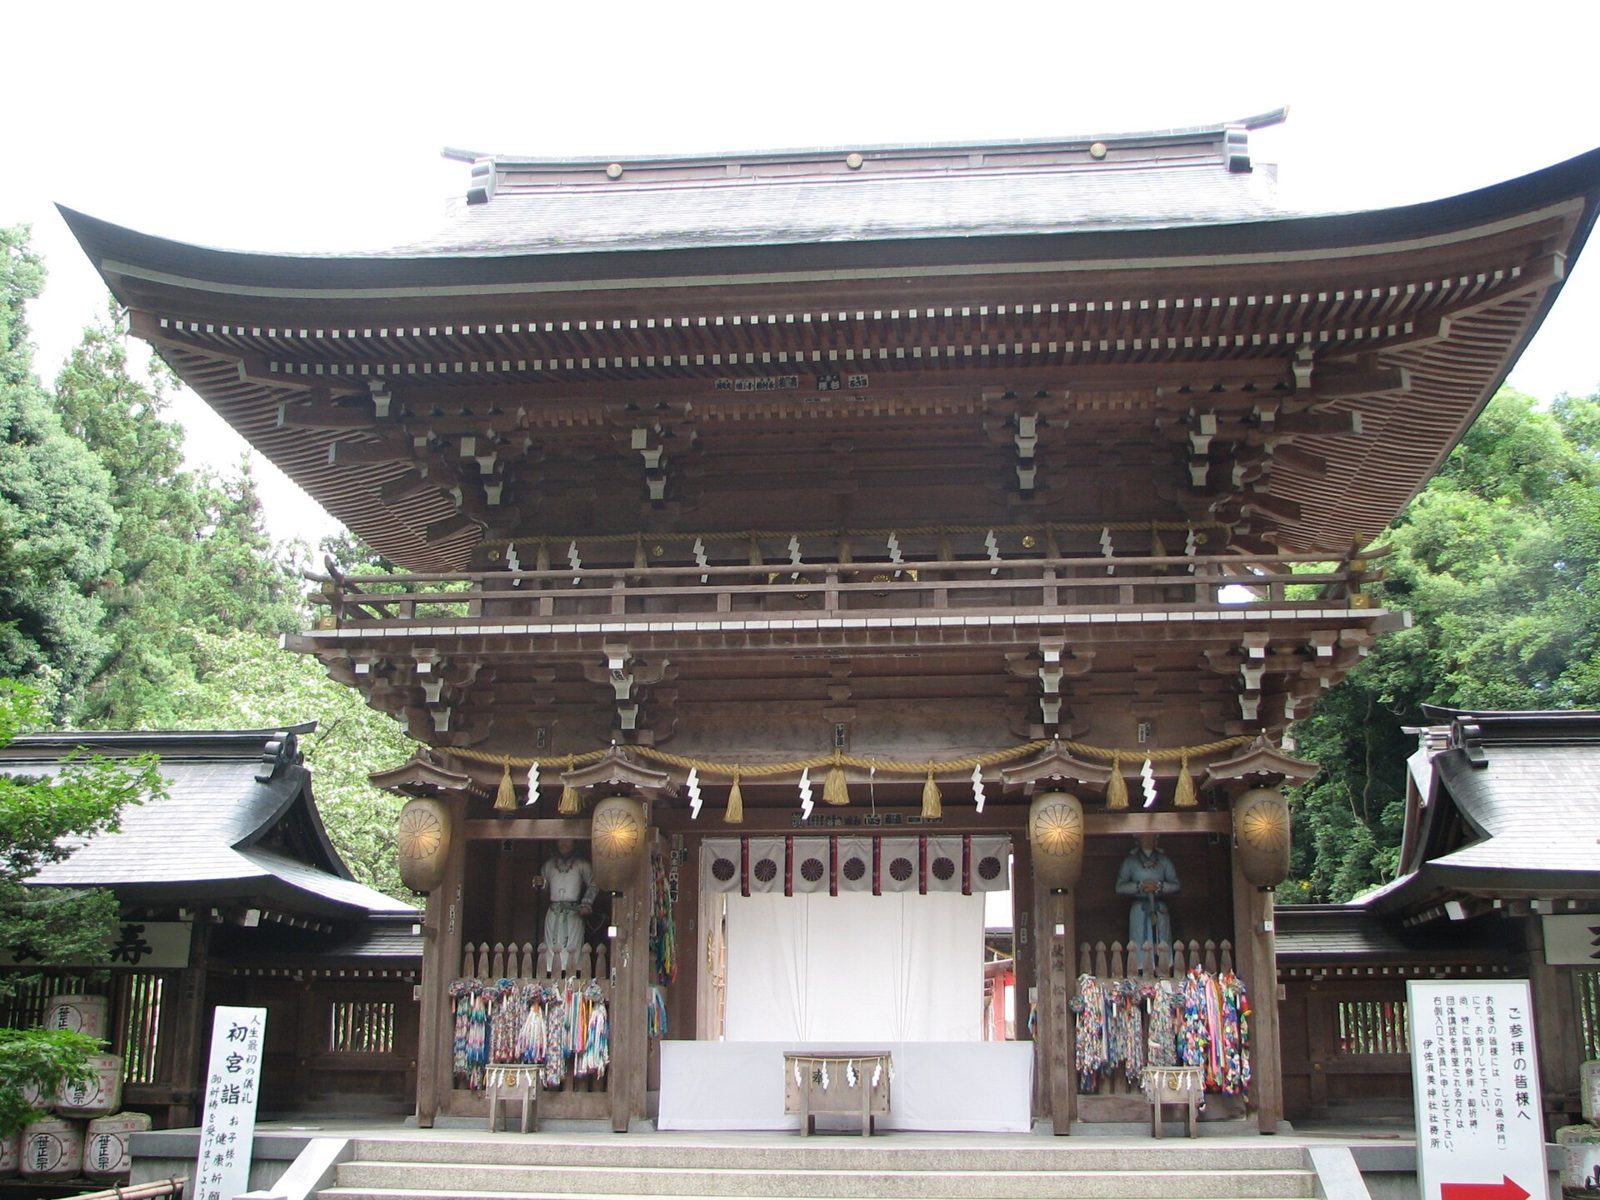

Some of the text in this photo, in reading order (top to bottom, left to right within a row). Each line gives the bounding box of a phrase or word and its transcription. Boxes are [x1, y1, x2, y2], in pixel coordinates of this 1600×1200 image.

[220, 1022, 248, 1105] 初宮詣
[241, 1015, 261, 1104] 人生最初の儀礼
[1423, 1039, 1440, 1149] 伊佐須美神社社務所
[1508, 1007, 1531, 1121] ご参拝の皆様へ
[36, 1135, 50, 1170] 笹正宗
[98, 1135, 112, 1170] 笹正宗
[225, 1116, 239, 1168] お子様の
